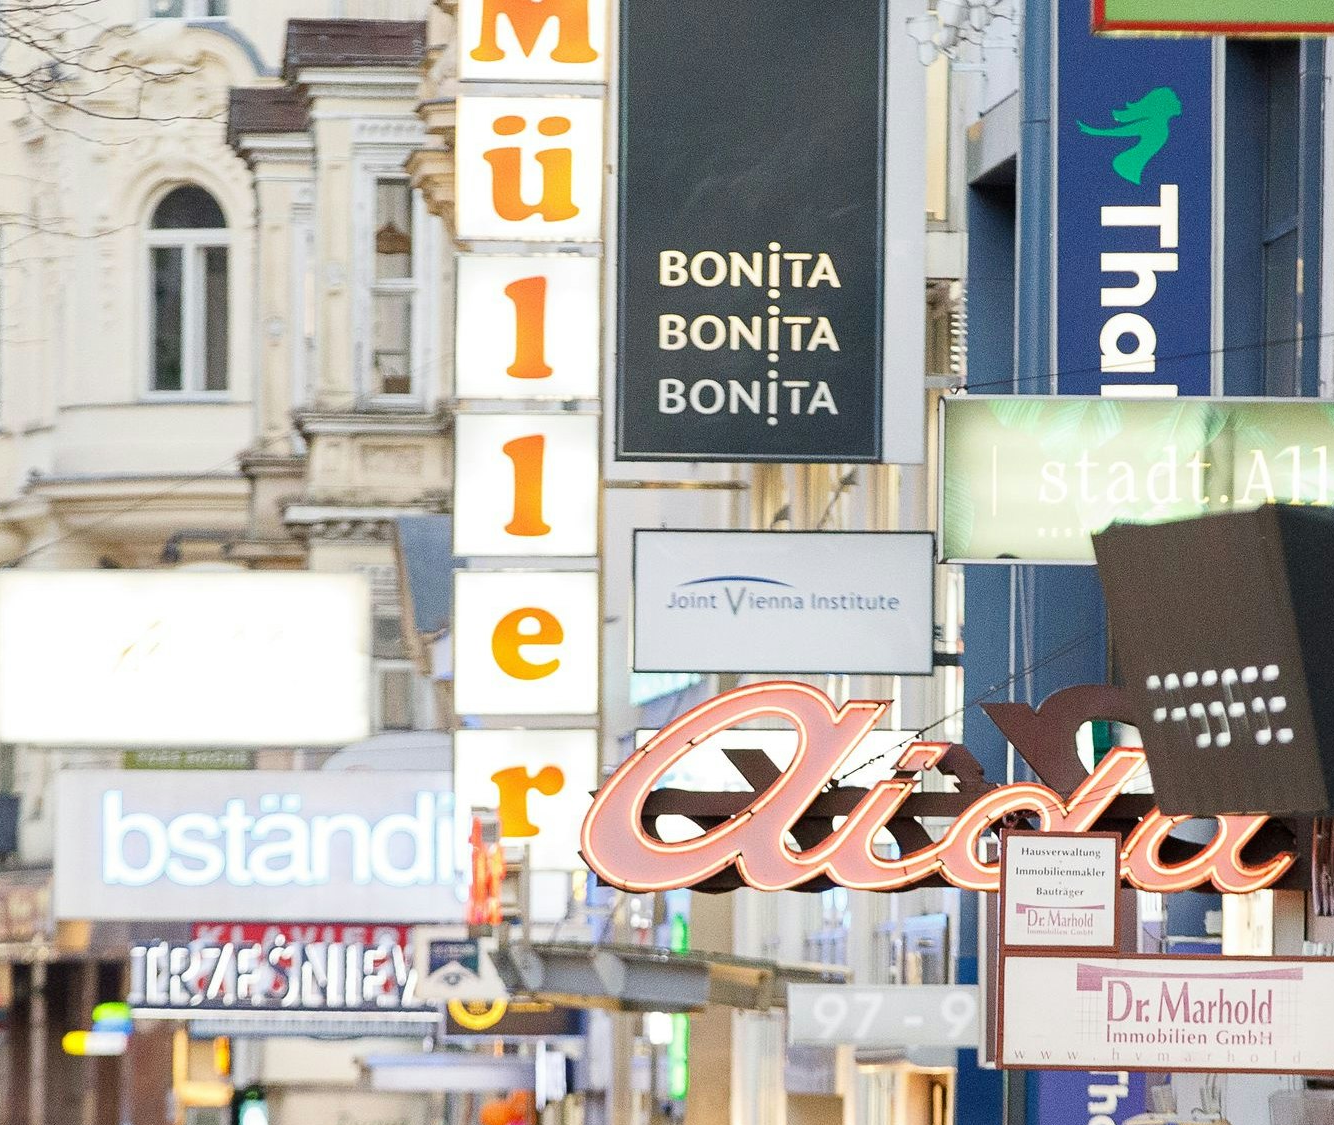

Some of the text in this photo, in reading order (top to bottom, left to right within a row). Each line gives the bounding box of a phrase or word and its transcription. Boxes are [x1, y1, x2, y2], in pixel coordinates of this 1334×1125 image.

[1100, 184, 1178, 397] Thal
[1038, 527, 1087, 538] REST
[667, 586, 899, 615] Joint Vienna Institute
[102, 789, 464, 890] bständi
[1021, 847, 1101, 859] Hausverwaltung
[1015, 867, 1105, 877] Immobilienmakler
[1036, 887, 1084, 898] Bauträger
[1027, 909, 1093, 927] Dr. Marhold
[1107, 980, 1273, 1025] Dr. Marhold
[813, 992, 884, 1039] 97
[941, 992, 977, 1038] 9
[1107, 1024, 1272, 1046] Immobilien GmbH
